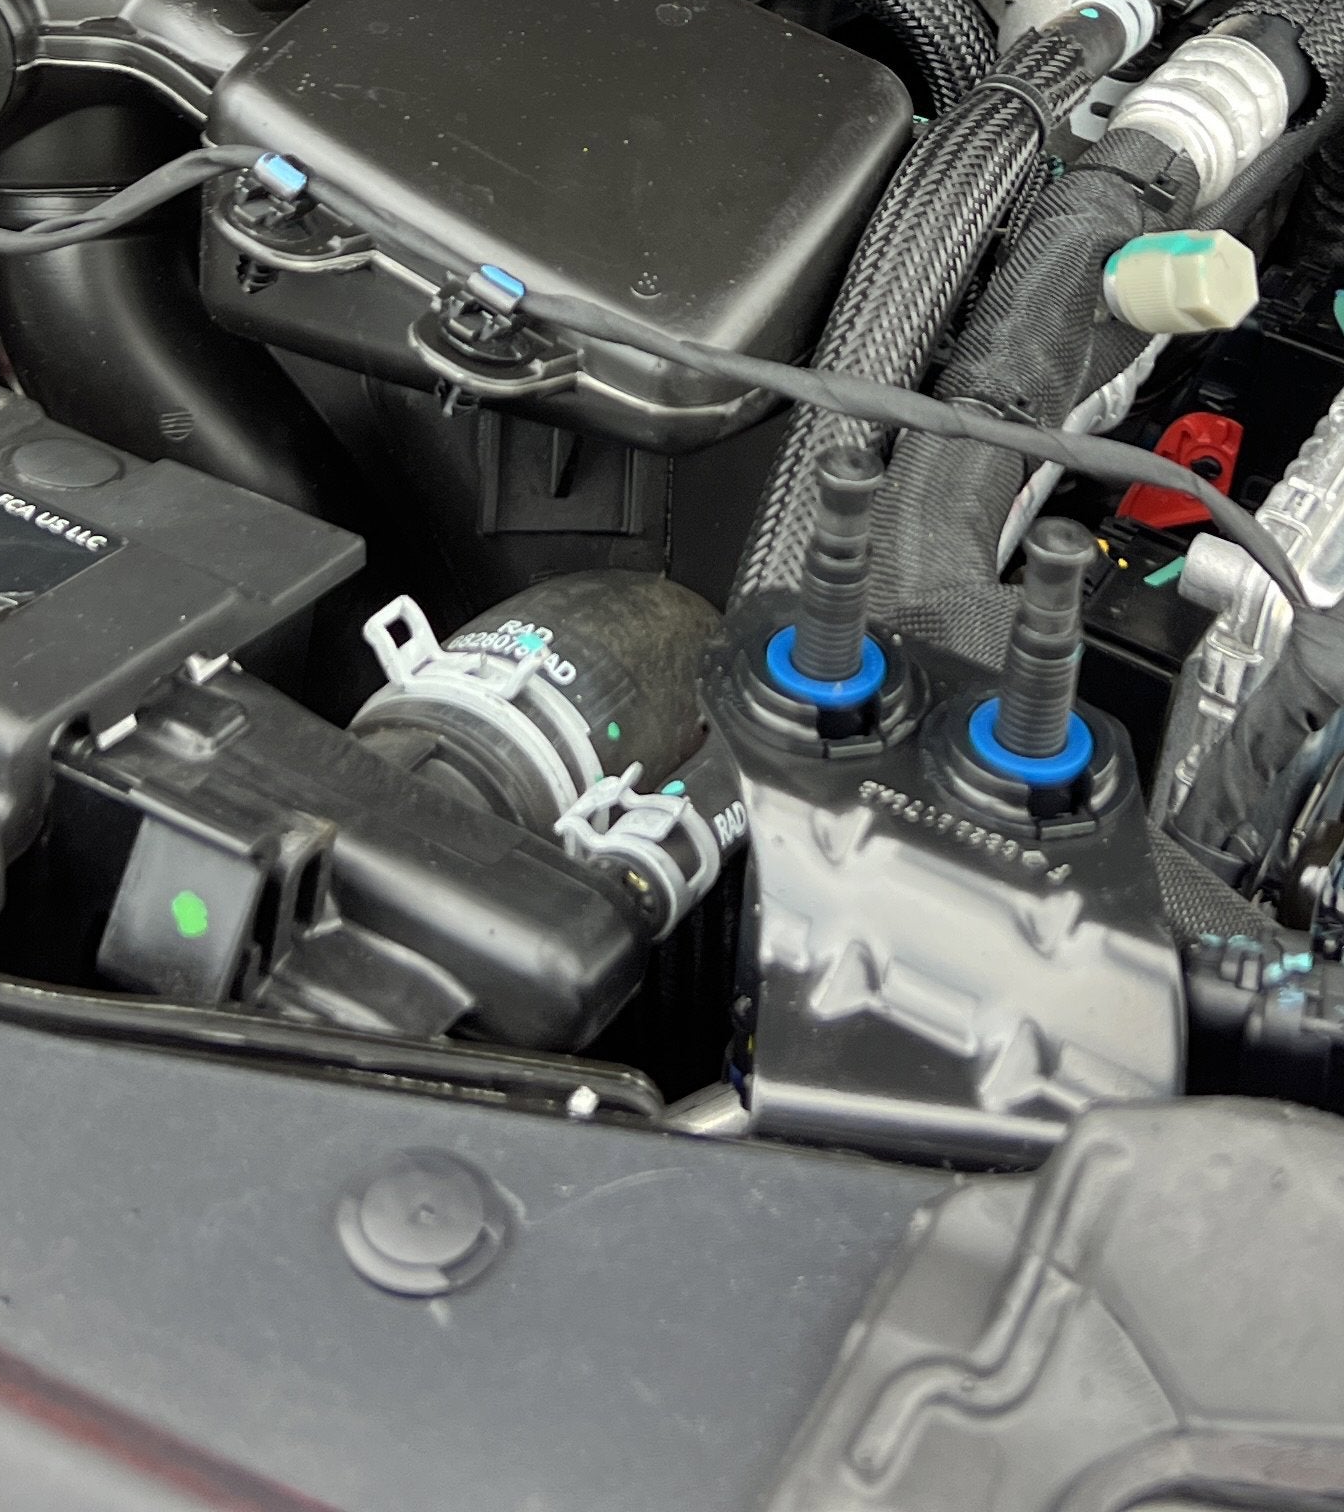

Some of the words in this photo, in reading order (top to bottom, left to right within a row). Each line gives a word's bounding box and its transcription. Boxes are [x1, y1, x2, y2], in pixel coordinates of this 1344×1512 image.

[34, 511, 70, 535] US
[64, 524, 109, 552] LLC
[497, 619, 554, 644] RAD
[713, 800, 747, 847] RAD
